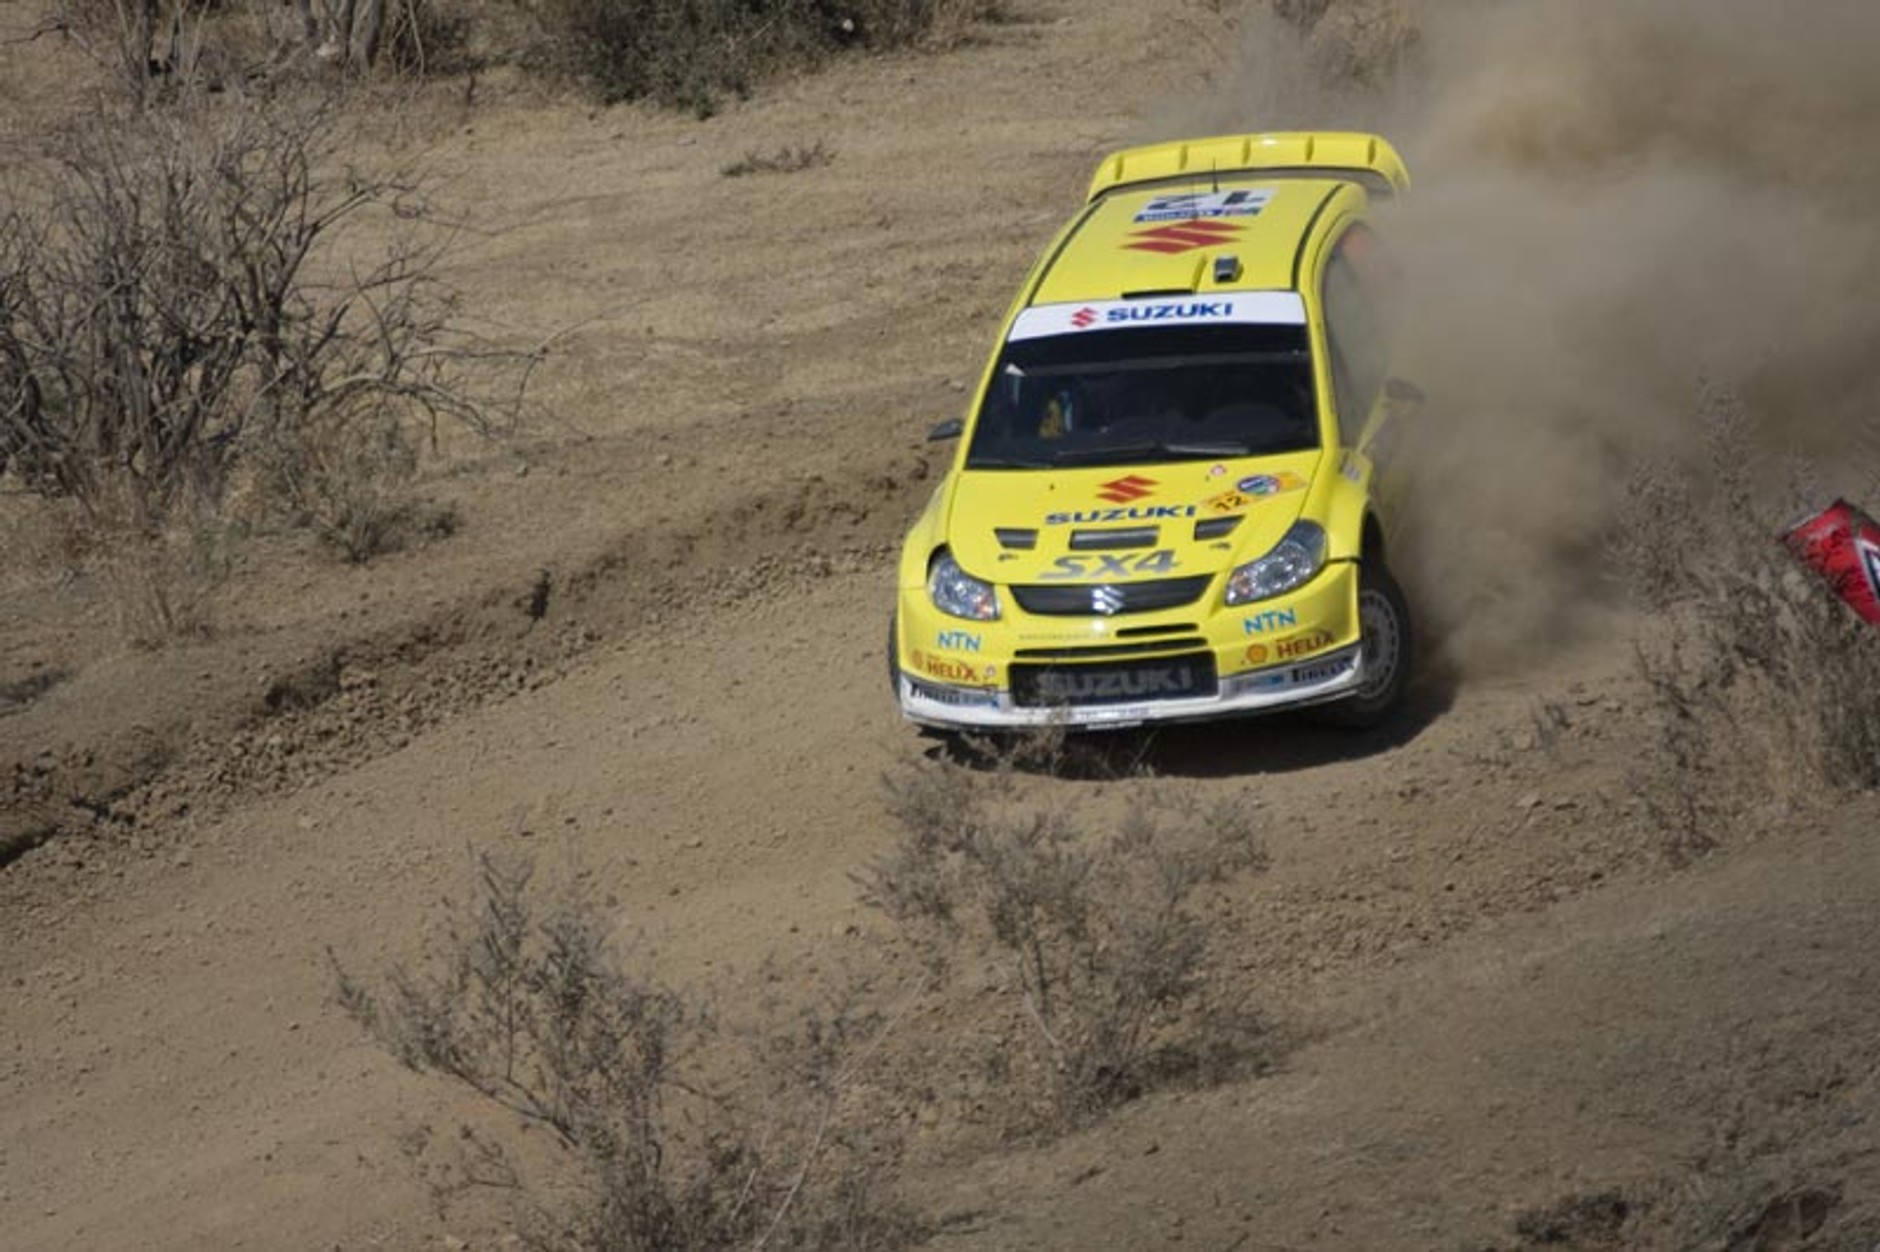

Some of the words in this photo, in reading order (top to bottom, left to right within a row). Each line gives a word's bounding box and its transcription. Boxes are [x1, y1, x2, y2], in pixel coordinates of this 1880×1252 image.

[1107, 302, 1234, 322] SUZUKI
[1044, 504, 1197, 525] SUZUKI
[1039, 549, 1181, 580] SX4
[1244, 608, 1297, 635] NTN
[937, 631, 982, 651] NTN
[1275, 630, 1336, 659] HELIX
[926, 658, 979, 682] HELIX
[1036, 665, 1193, 698] SUZUKI
